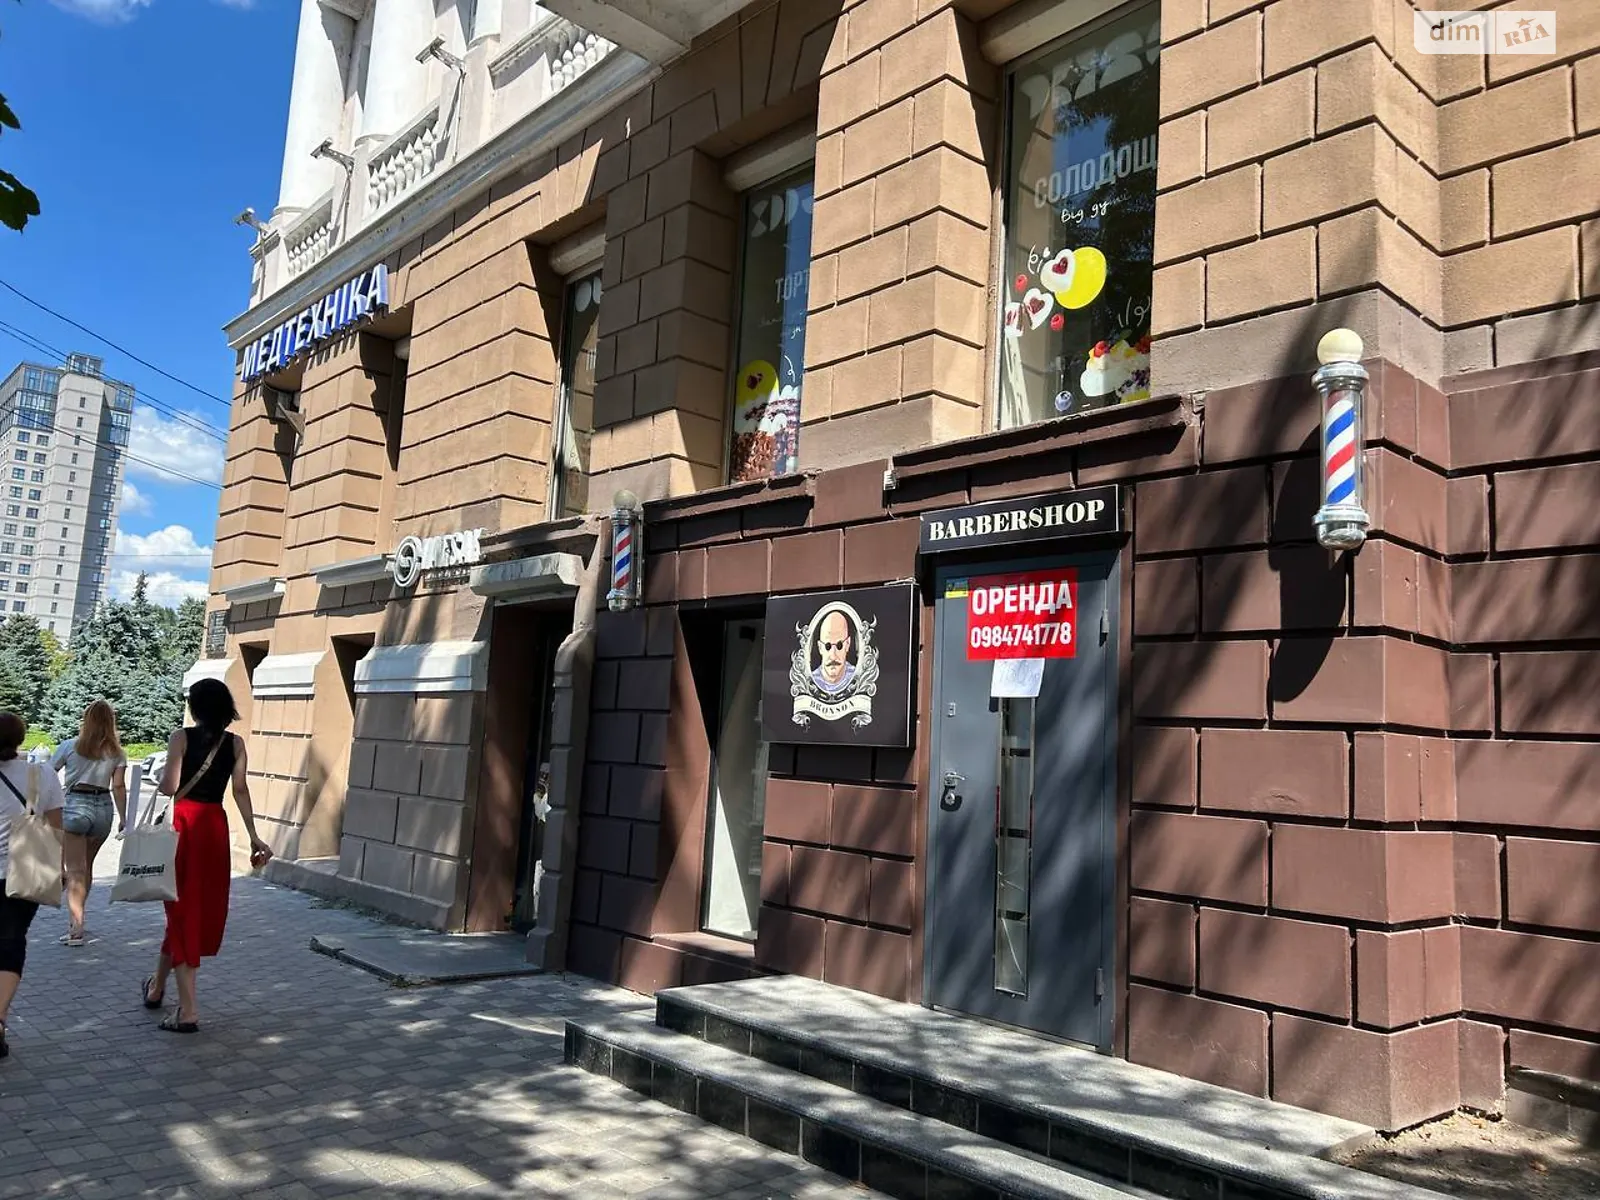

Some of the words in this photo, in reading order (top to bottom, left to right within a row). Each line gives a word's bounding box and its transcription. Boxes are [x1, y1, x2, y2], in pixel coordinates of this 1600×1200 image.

[240, 263, 390, 383] МЕДТЕХНІКА
[929, 499, 1105, 541] BARBERSHOP
[972, 580, 1073, 616] ОРЕНДА
[970, 621, 1072, 649] 0984741778
[809, 699, 855, 715] BRONSON
